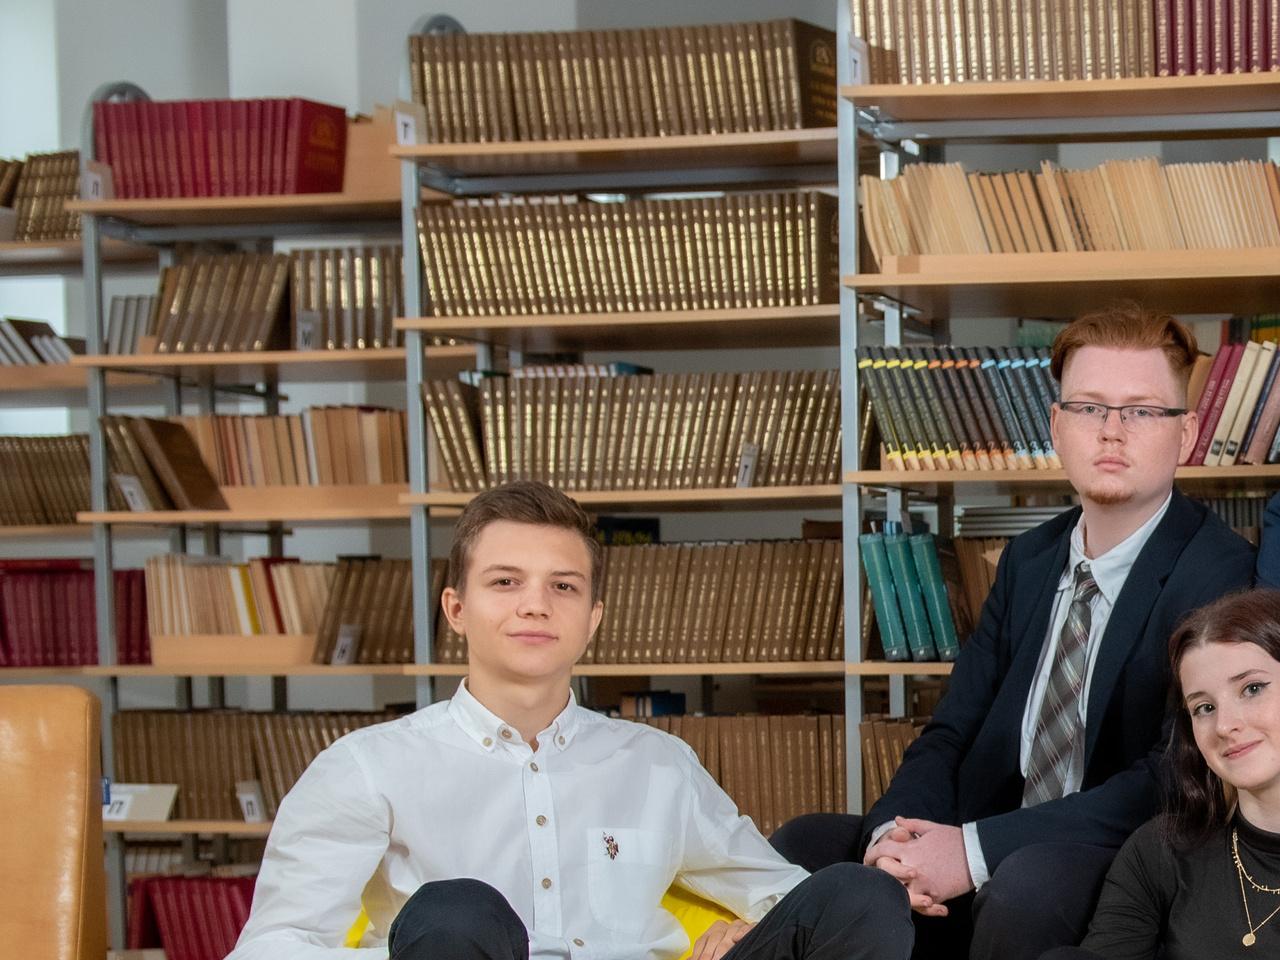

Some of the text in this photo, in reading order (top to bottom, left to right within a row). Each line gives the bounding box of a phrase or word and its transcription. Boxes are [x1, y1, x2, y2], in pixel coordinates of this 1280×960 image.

[301, 330, 311, 347] М
[886, 443, 892, 452] 1
[902, 443, 909, 452] 1
[916, 443, 923, 452] 1
[931, 443, 938, 452] 1
[945, 443, 952, 452] 1
[1013, 440, 1022, 452] 3
[1029, 440, 1038, 451] 3
[1043, 440, 1052, 451] 3
